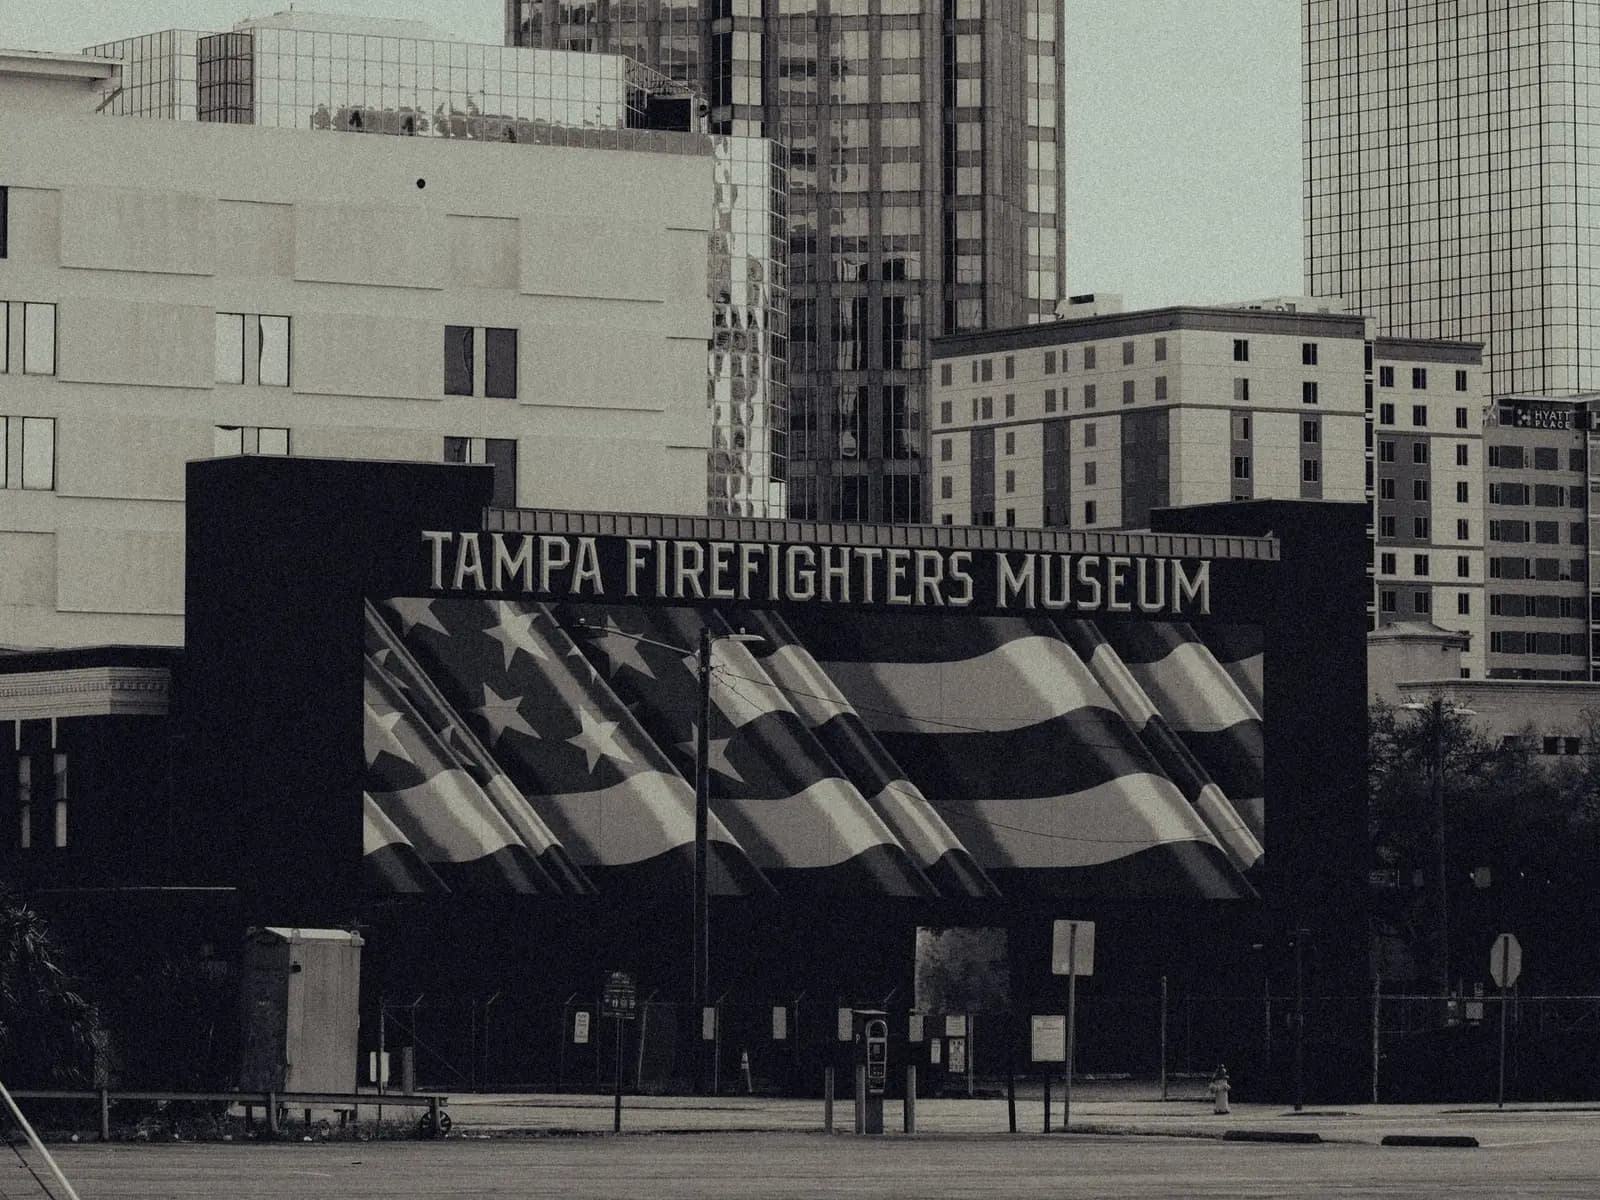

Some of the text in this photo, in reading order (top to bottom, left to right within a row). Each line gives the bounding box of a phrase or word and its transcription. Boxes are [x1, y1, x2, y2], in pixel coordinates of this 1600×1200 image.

[1535, 409, 1571, 421] HYATT
[1535, 420, 1571, 430] PLACE
[421, 530, 1212, 616] TAMPA FIREFIGHTERS MUSEUM
